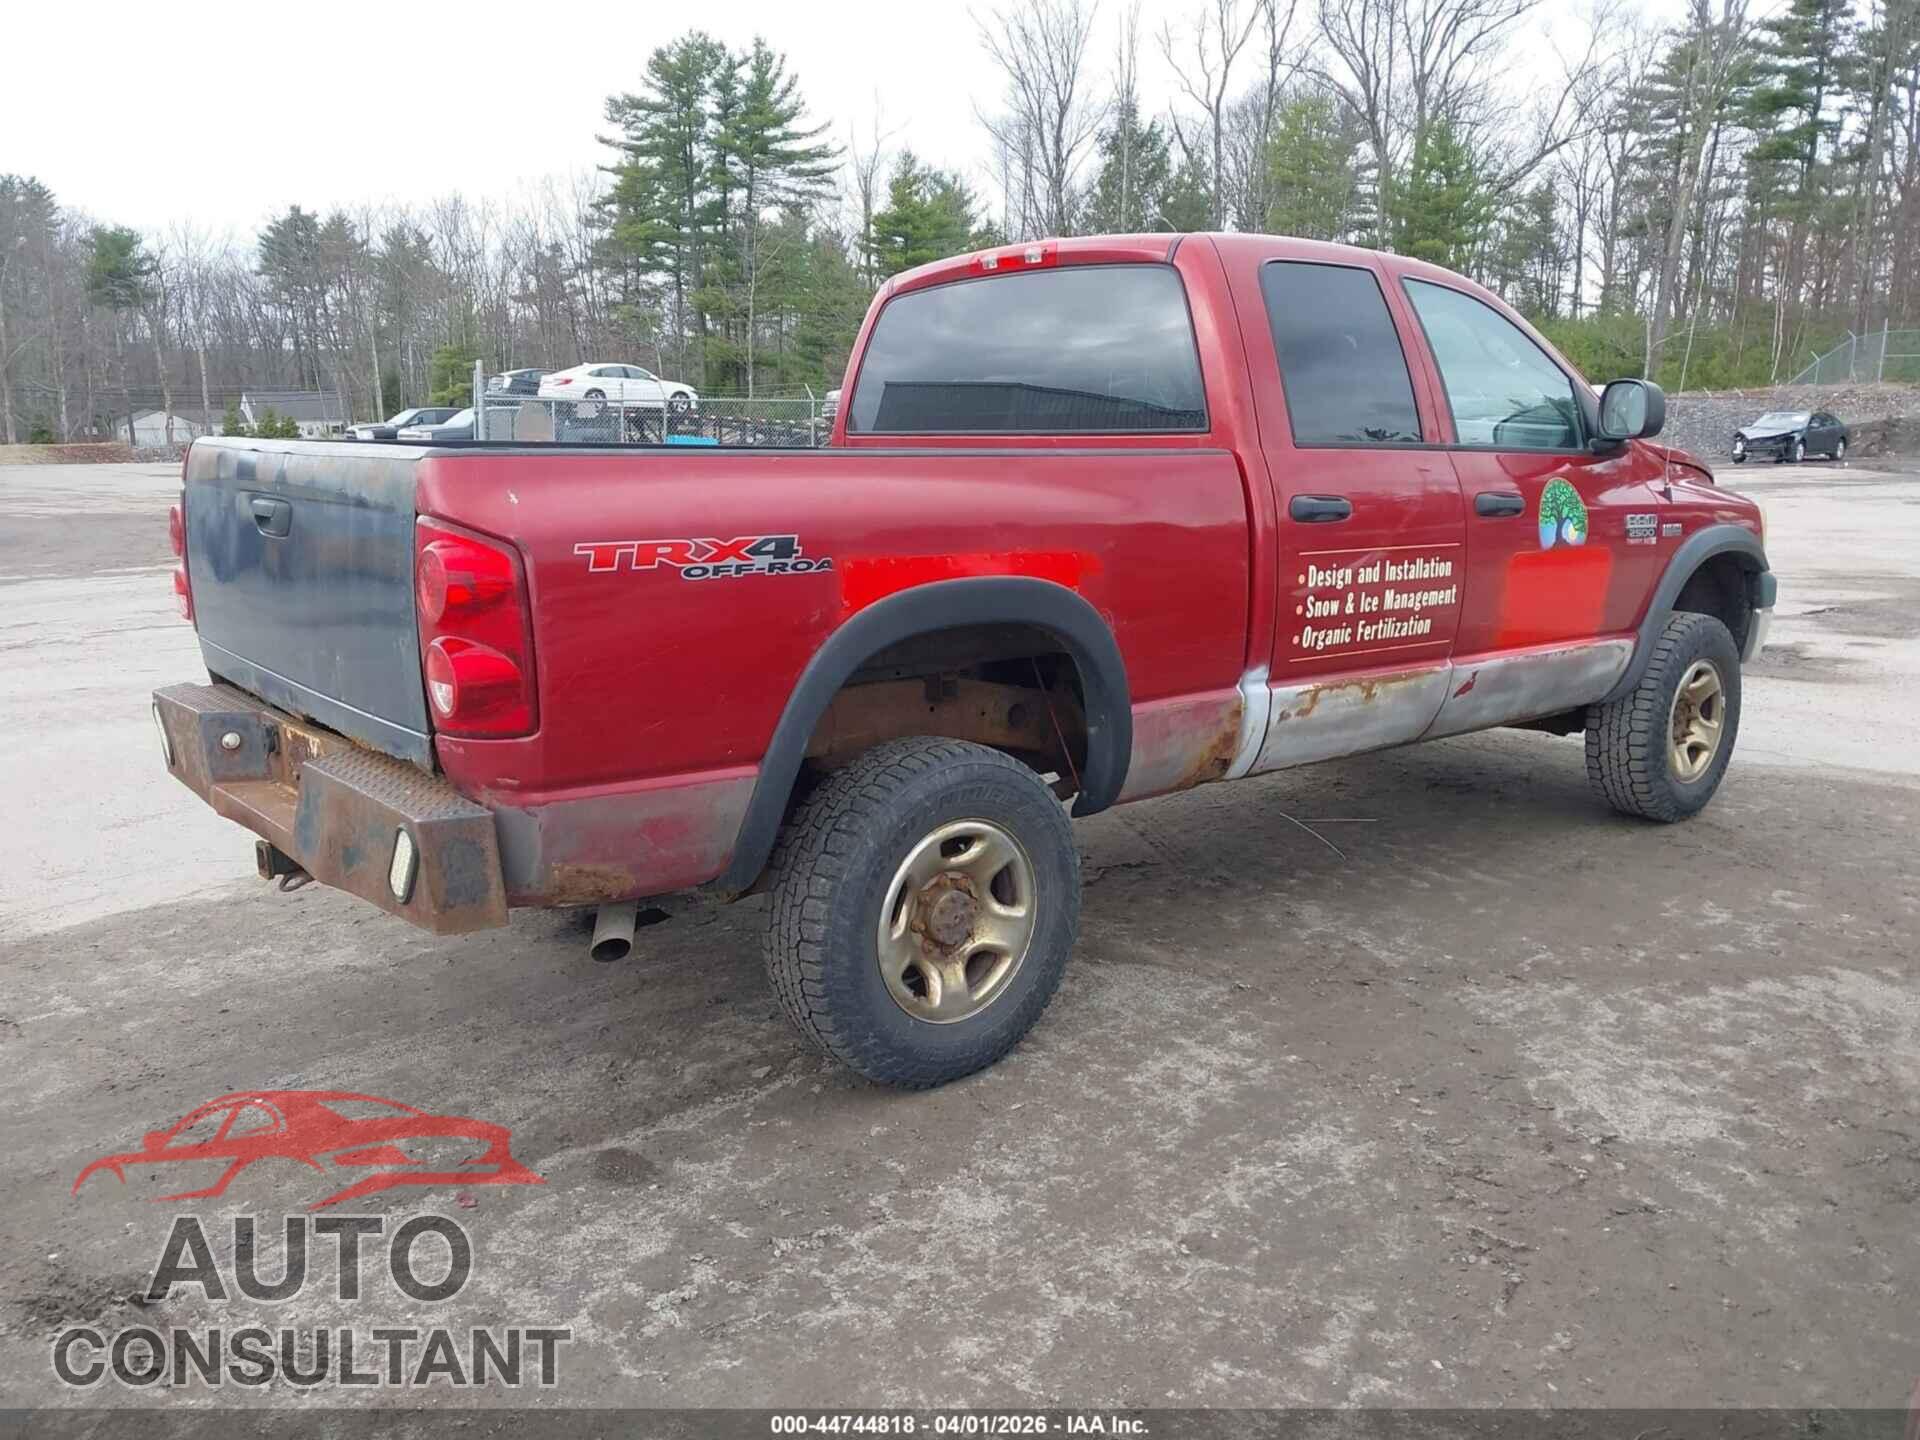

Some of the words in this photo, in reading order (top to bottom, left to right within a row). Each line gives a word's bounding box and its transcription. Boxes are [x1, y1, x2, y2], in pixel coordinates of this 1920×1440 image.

[574, 534, 801, 572] TRX4
[681, 557, 833, 580] OFF-ROA
[1308, 563, 1353, 590] Design
[1357, 560, 1381, 584] and
[1385, 556, 1453, 581] Installation
[1305, 595, 1340, 619] Snow
[1344, 591, 1355, 615] &
[1359, 591, 1379, 613] Ice
[1383, 584, 1457, 611] Management
[1302, 622, 1352, 651] Organic
[1356, 614, 1432, 642] Fertilization
